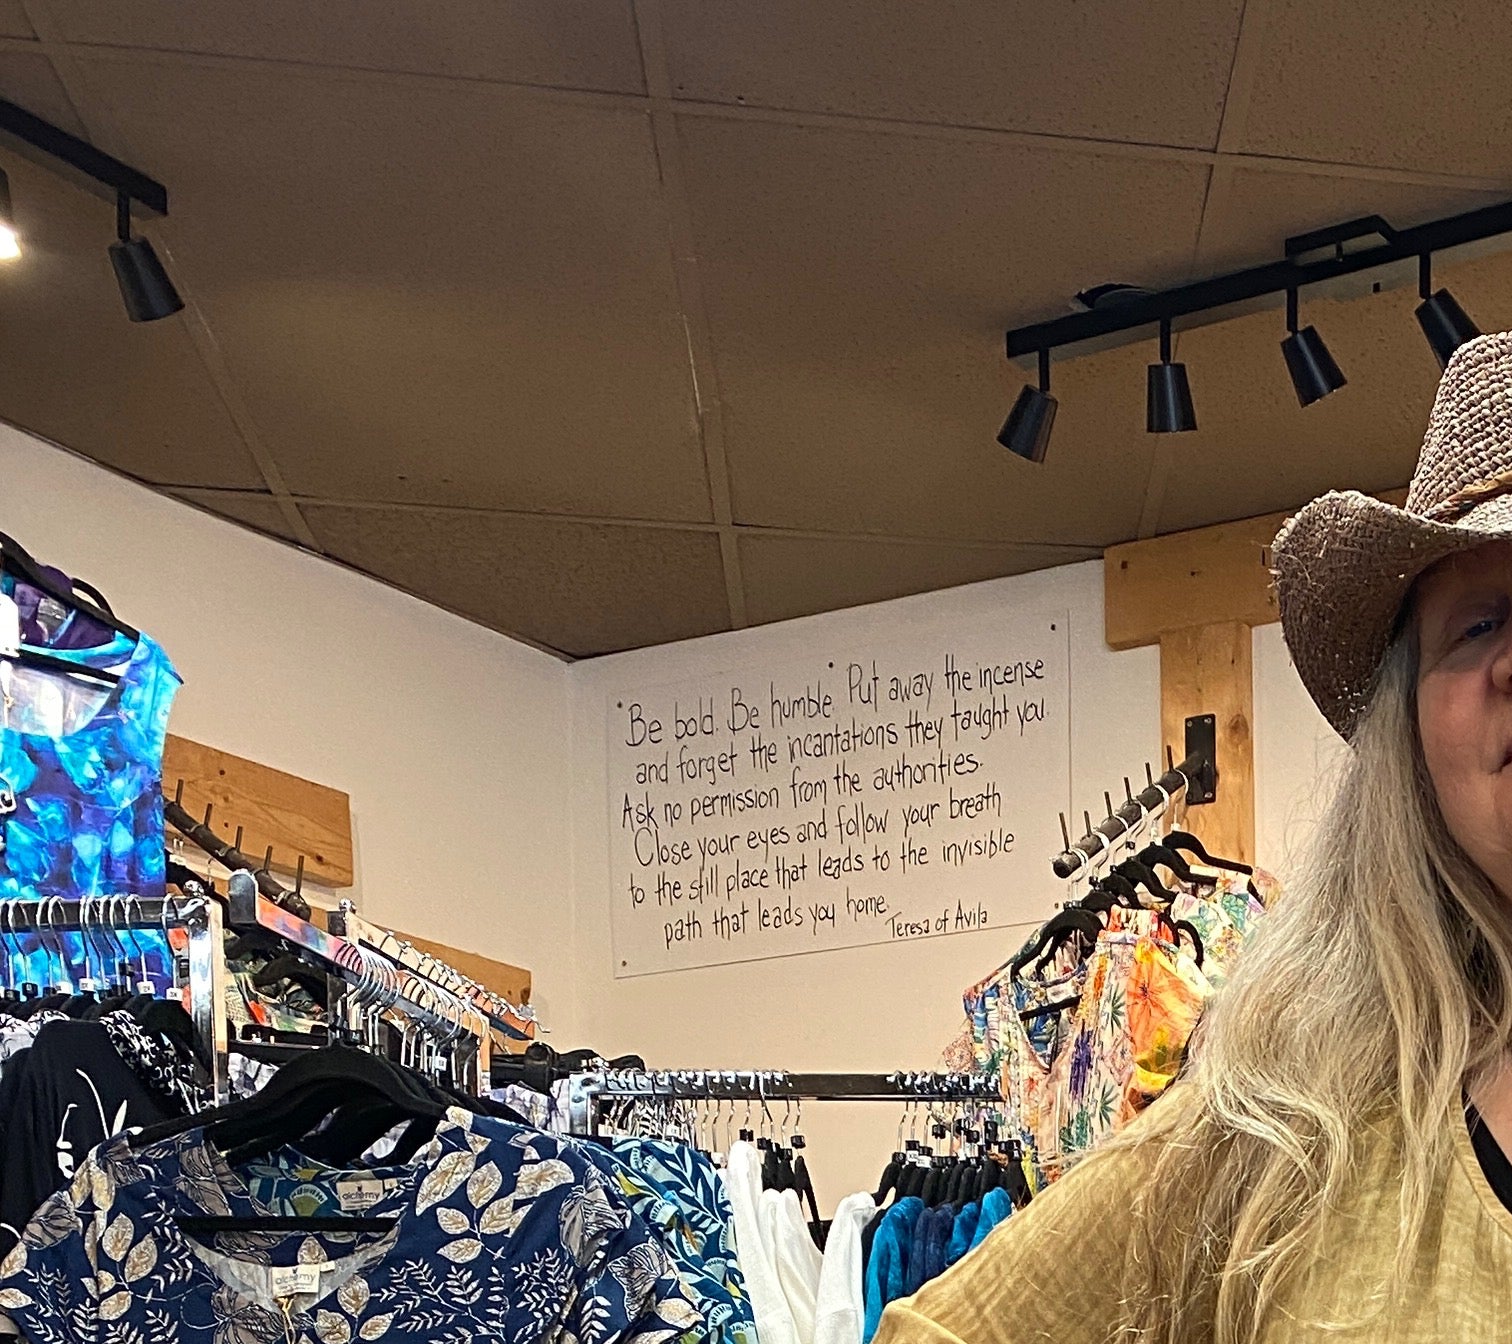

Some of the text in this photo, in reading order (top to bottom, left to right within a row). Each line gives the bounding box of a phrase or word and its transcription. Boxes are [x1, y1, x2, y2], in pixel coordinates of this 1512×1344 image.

[625, 654, 1044, 748] Be bold. Be humble. Put away the incense
[635, 751, 669, 786] and
[676, 742, 737, 784] forget
[751, 733, 778, 772] the
[788, 717, 899, 762] incantations
[906, 708, 943, 749] they
[951, 695, 1009, 741] taught
[622, 750, 983, 833] Ask no permission from the authorities.
[634, 782, 1002, 871] Close your eyes and follow your breath
[628, 829, 1016, 908] to the still place that leads to the invisible
[664, 909, 703, 950] path
[712, 901, 749, 940] that
[758, 893, 804, 933] leads
[808, 902, 836, 936] you
[886, 901, 987, 938] Teresa of Avila
[342, 1190, 380, 1200] alchemy
[275, 1273, 317, 1285] alchemy
